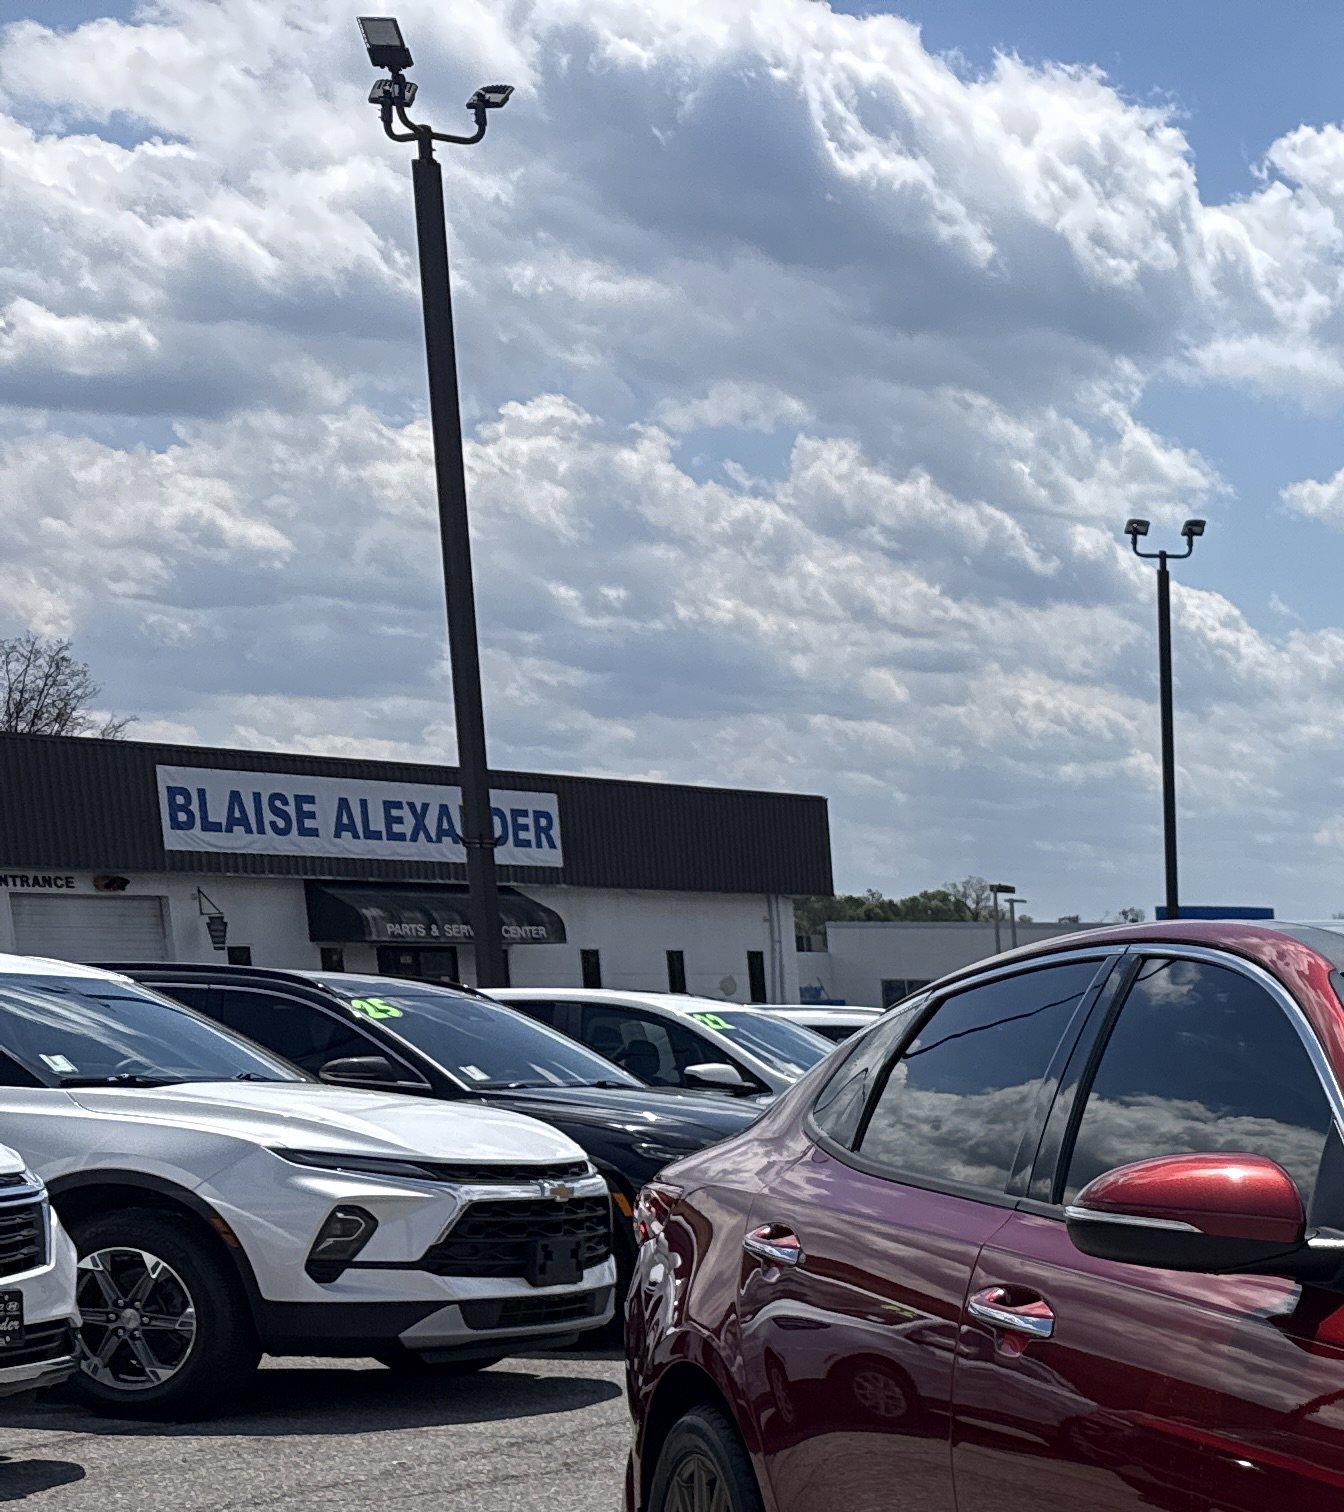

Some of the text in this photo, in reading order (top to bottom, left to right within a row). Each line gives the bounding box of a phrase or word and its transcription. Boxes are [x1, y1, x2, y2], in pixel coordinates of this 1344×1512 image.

[166, 785, 558, 850] BLAISE ALEXADER
[386, 923, 426, 937] PARTS
[430, 924, 440, 937] &
[501, 925, 547, 938] CENTER
[350, 998, 403, 1019] 25
